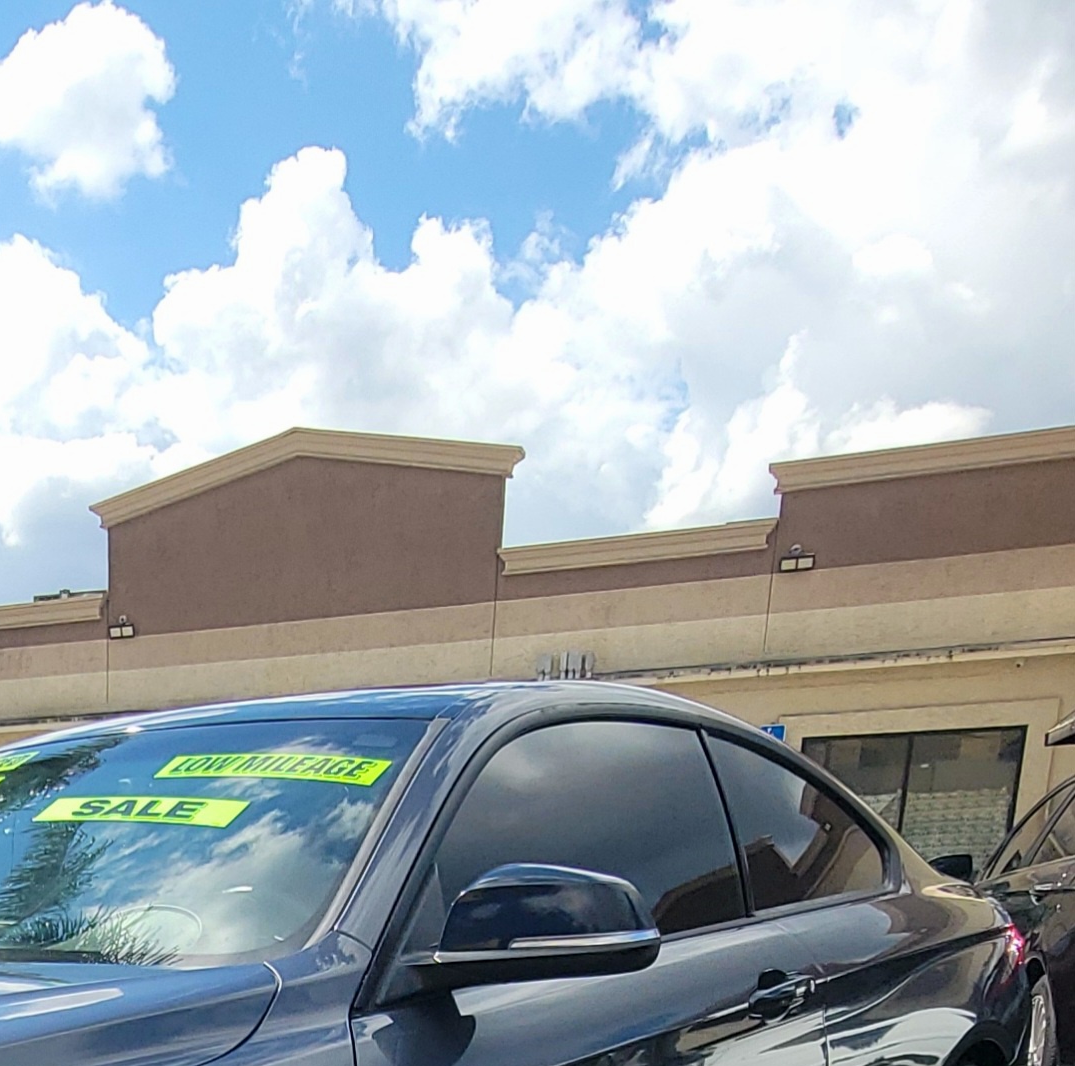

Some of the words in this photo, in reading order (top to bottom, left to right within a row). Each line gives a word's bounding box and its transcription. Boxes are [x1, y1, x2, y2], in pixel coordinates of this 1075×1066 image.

[169, 756, 235, 775] LOW
[233, 756, 378, 780] MILEAGE
[72, 799, 208, 821] SALE
